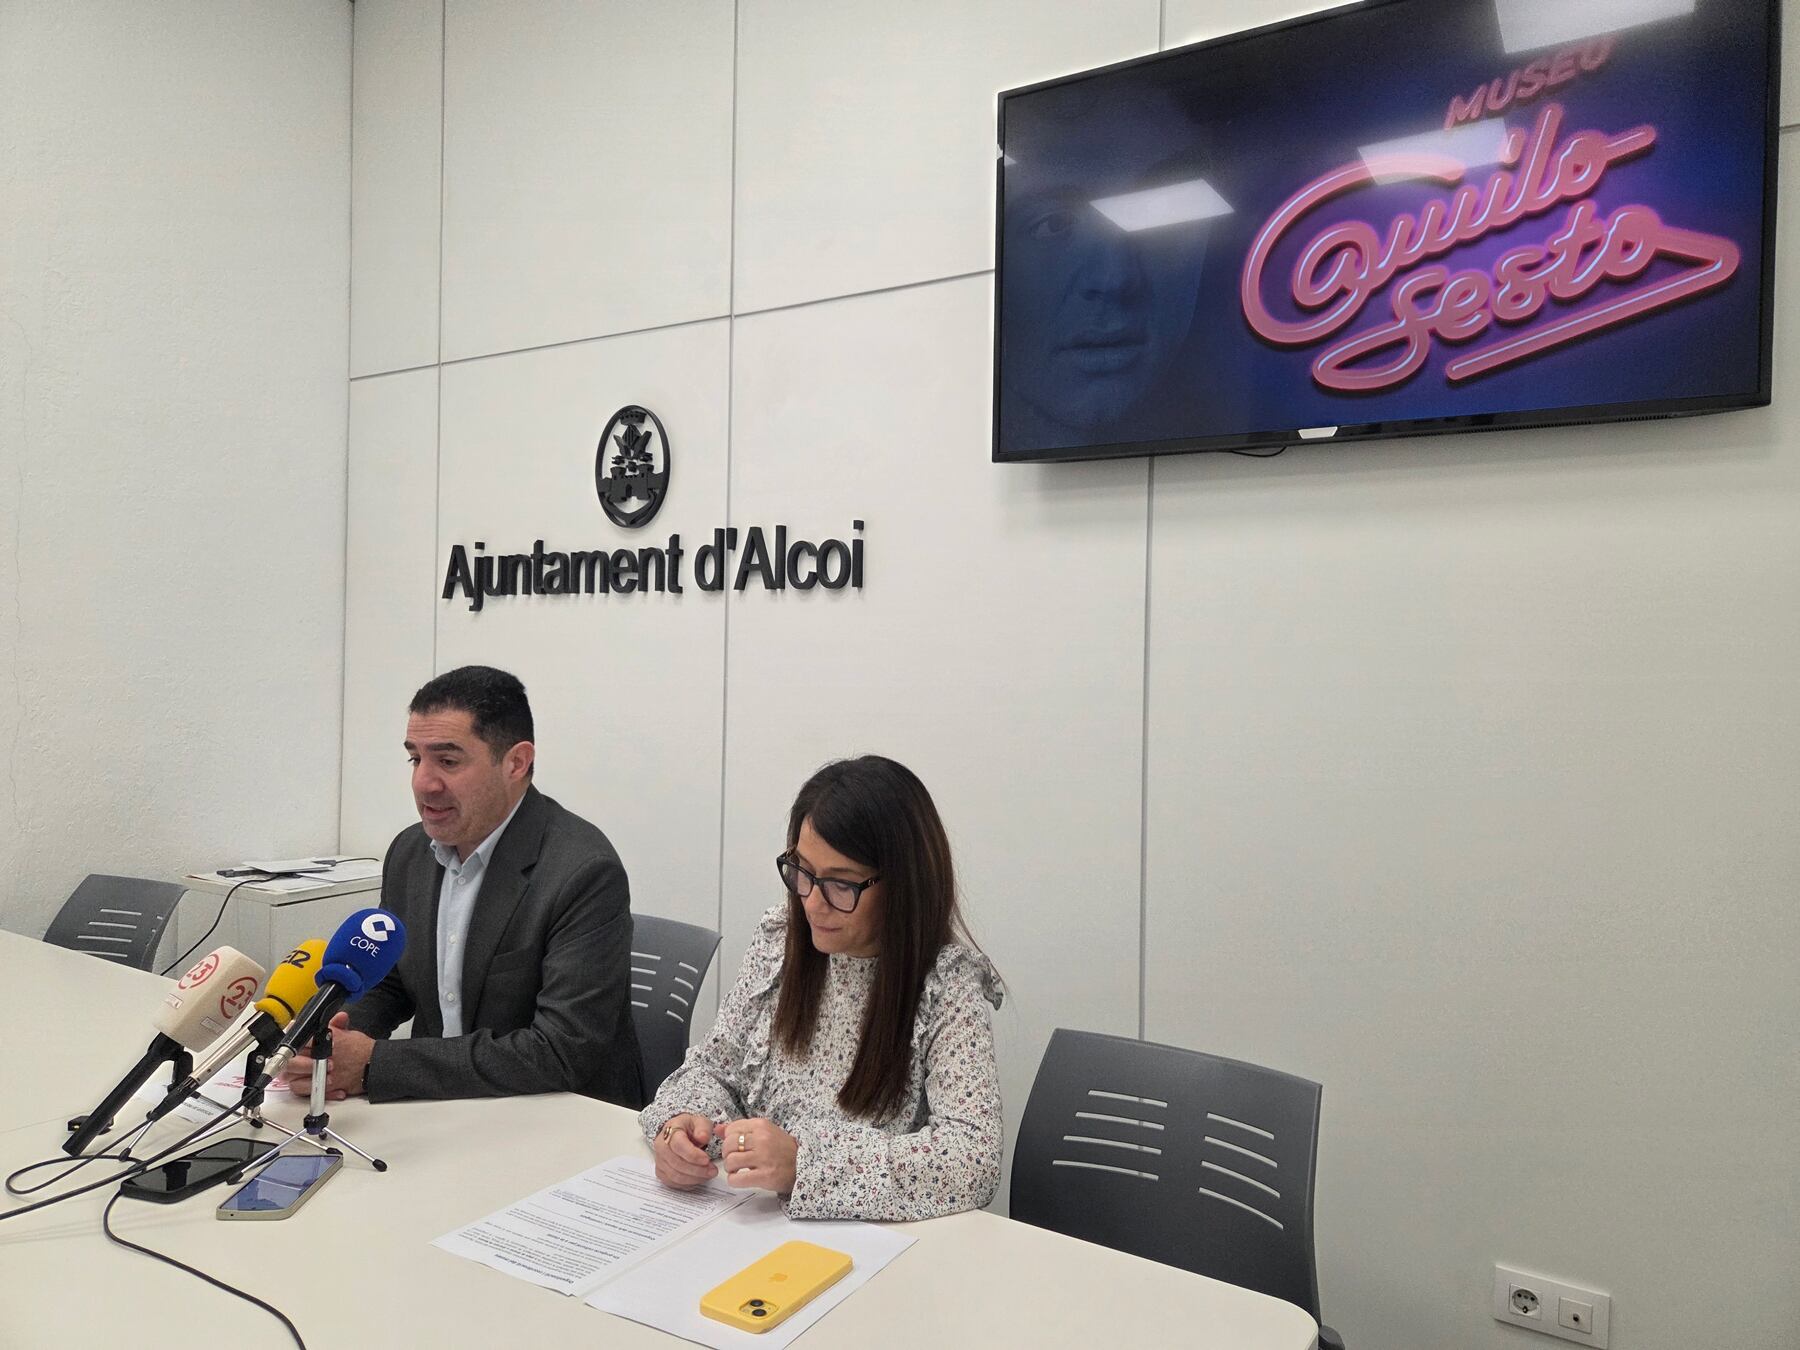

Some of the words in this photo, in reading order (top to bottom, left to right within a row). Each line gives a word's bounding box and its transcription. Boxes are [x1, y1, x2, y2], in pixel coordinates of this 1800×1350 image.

[1242, 104, 1656, 343] Camilo
[1312, 200, 1741, 390] Sesto
[442, 533, 683, 612] Ajuntament
[694, 520, 865, 592] d'Alcoi
[350, 935, 381, 958] COPE
